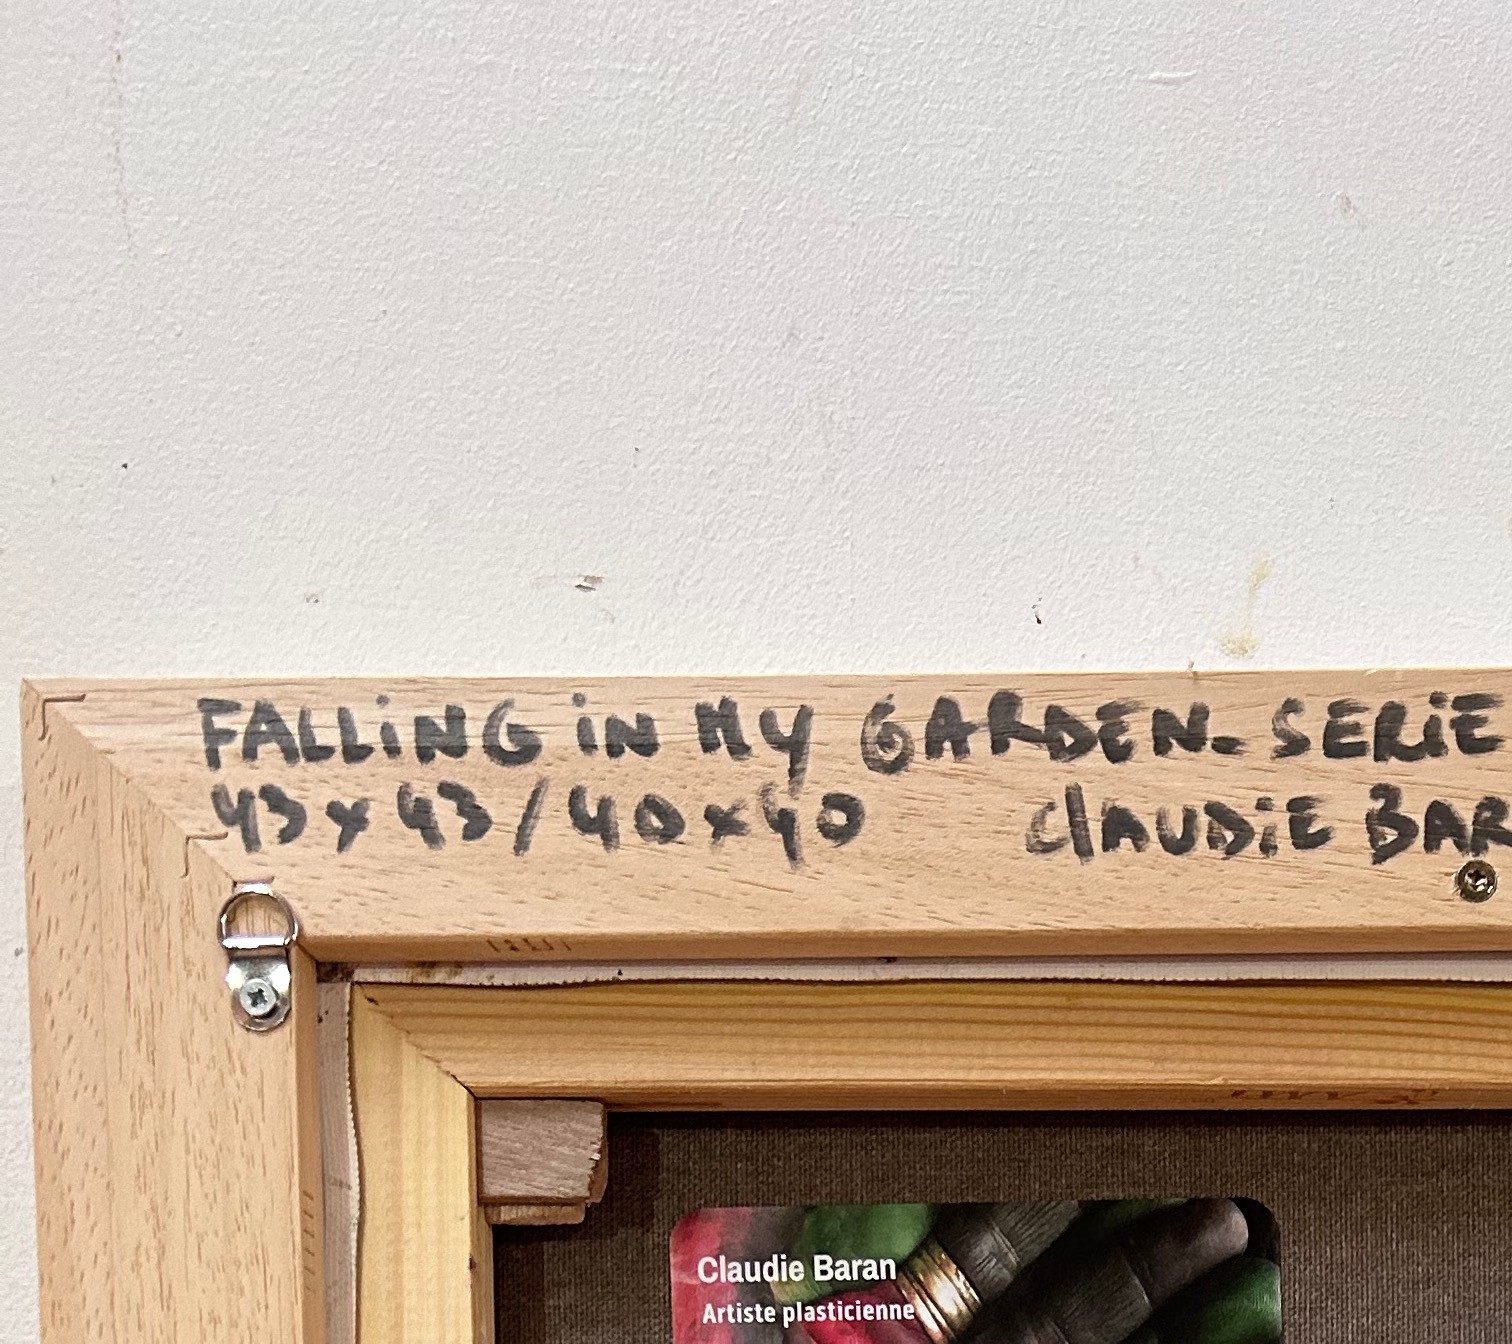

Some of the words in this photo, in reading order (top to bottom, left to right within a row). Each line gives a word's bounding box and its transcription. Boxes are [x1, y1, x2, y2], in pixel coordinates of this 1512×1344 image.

[694, 695, 814, 796] MY
[698, 1254, 805, 1283] Claudie
[813, 1254, 897, 1282] Baran
[702, 1303, 776, 1324] Artiste
[783, 1302, 915, 1328] plasticienne
